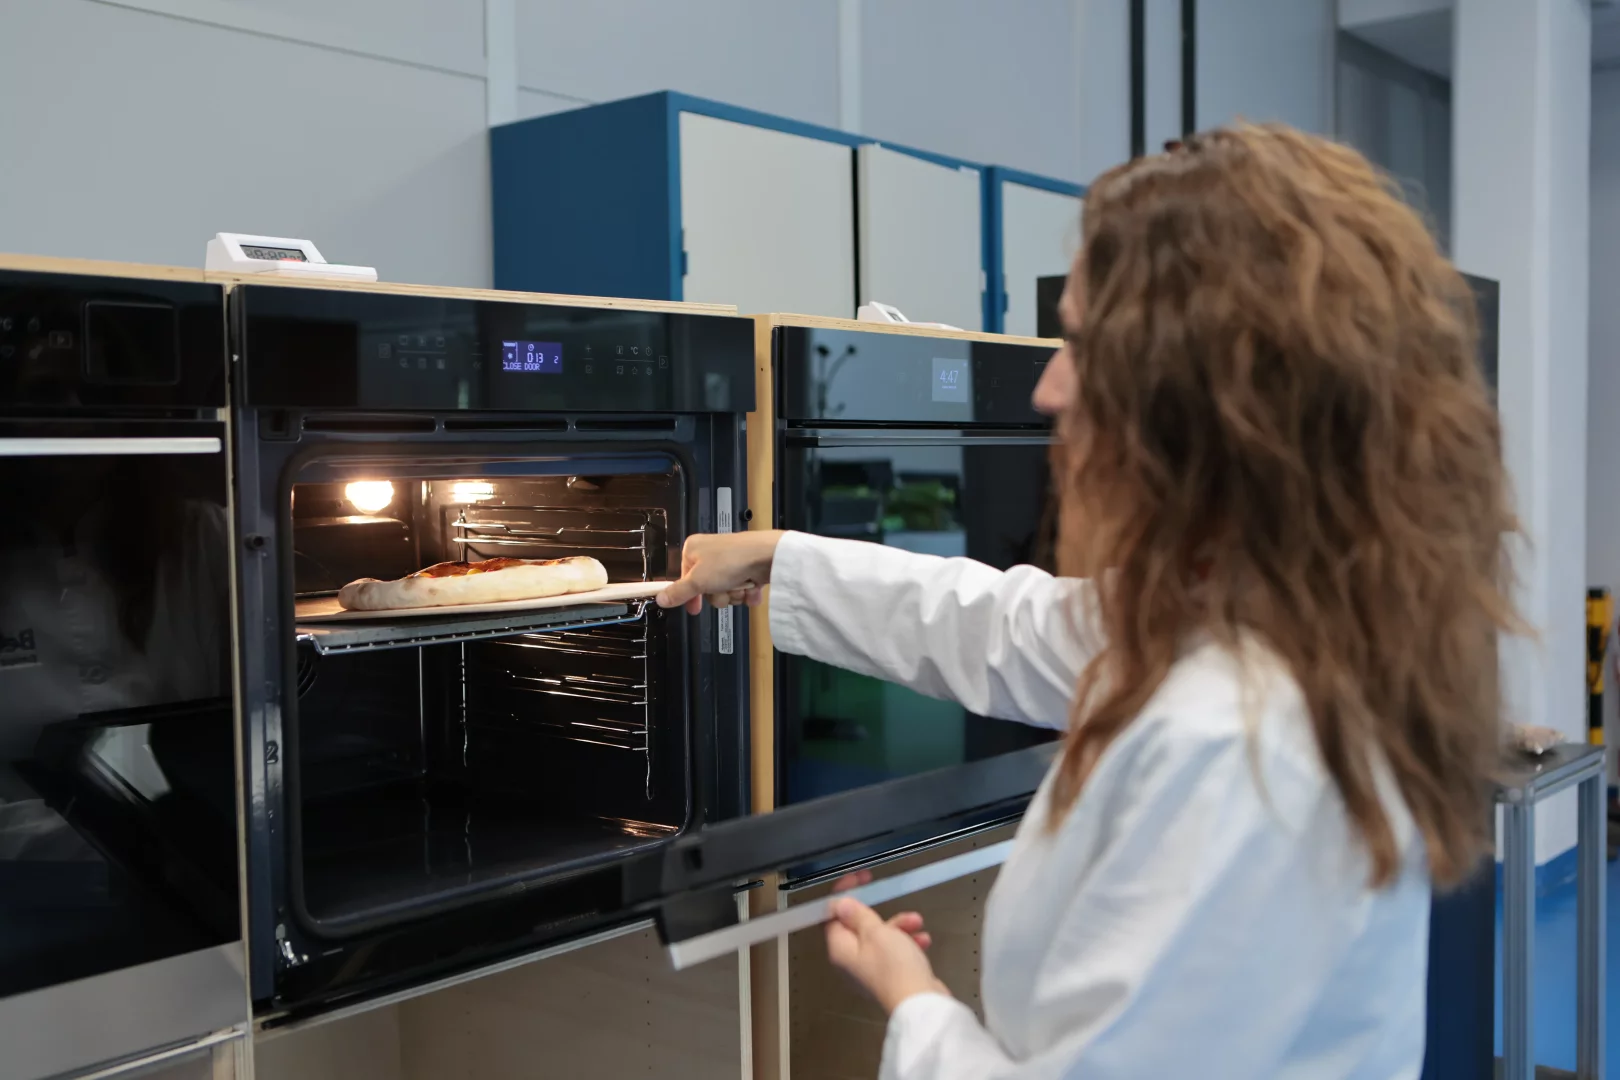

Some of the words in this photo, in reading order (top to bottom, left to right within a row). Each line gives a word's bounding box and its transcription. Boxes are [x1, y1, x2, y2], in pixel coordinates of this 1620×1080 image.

[553, 355, 559, 364] 2
[524, 362, 541, 371] DOOR
[939, 370, 959, 384] 4:47
